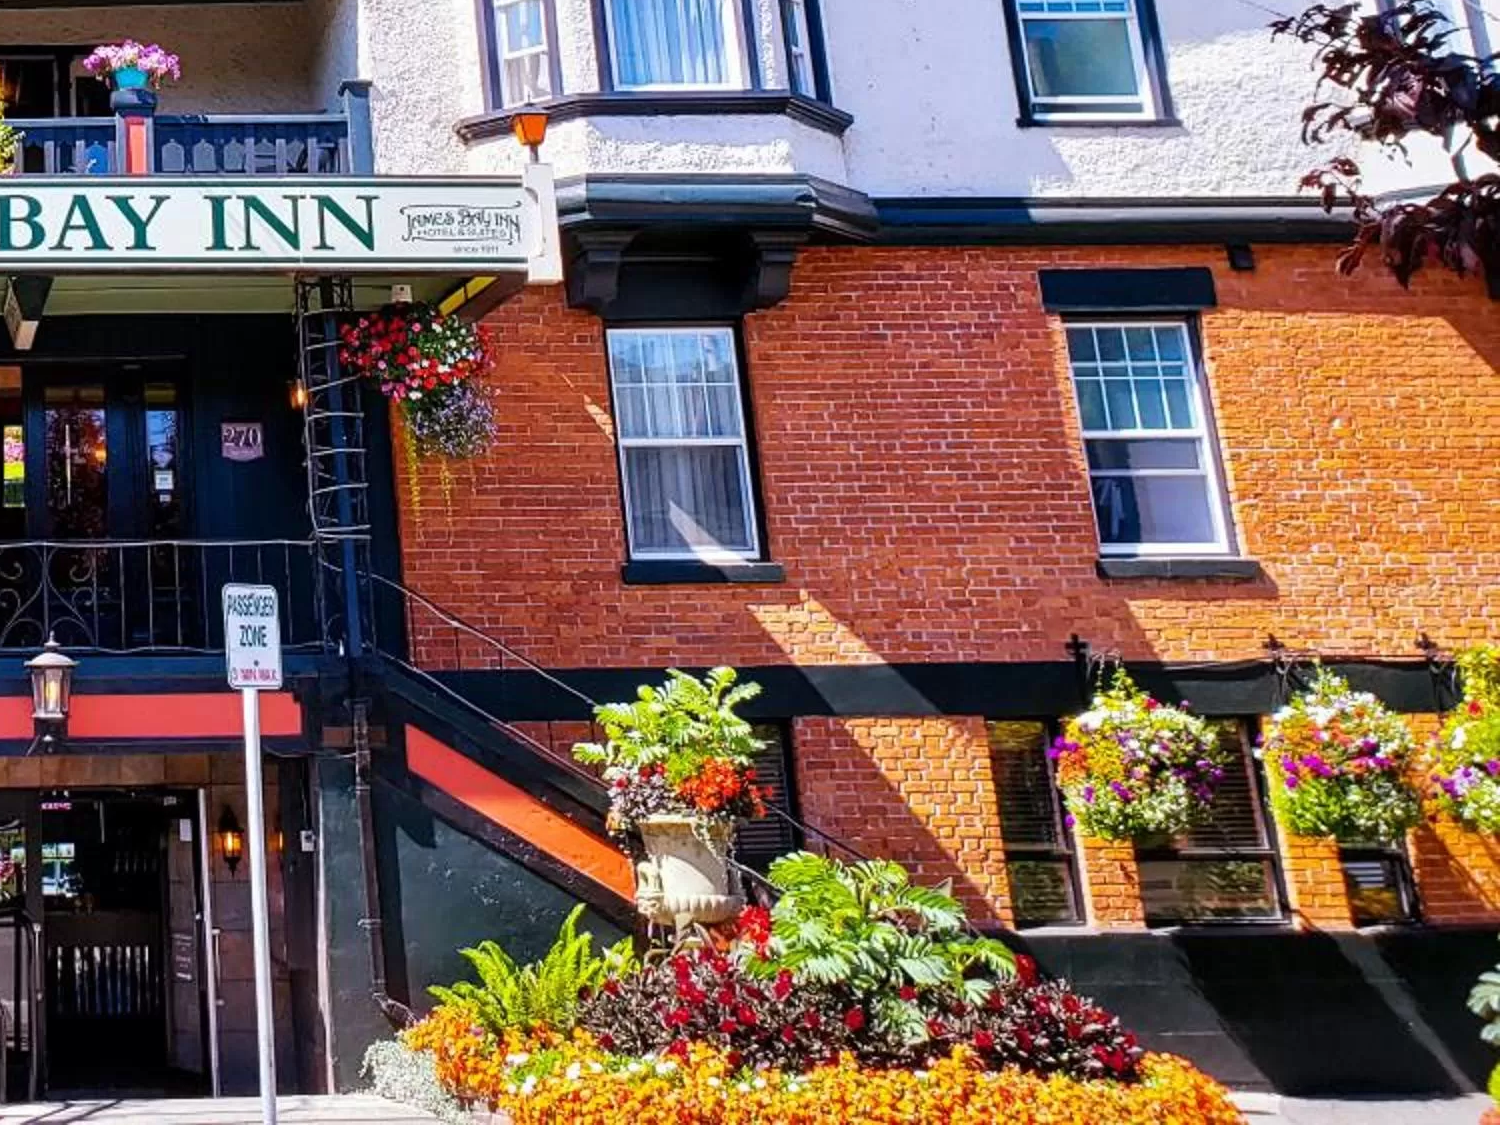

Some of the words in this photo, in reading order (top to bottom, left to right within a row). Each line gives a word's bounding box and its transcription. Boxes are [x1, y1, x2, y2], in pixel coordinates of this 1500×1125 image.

[203, 194, 380, 252] INN
[402, 211, 455, 241] JAMES
[227, 594, 275, 616] PASSENGER
[240, 624, 267, 647] ZONE
